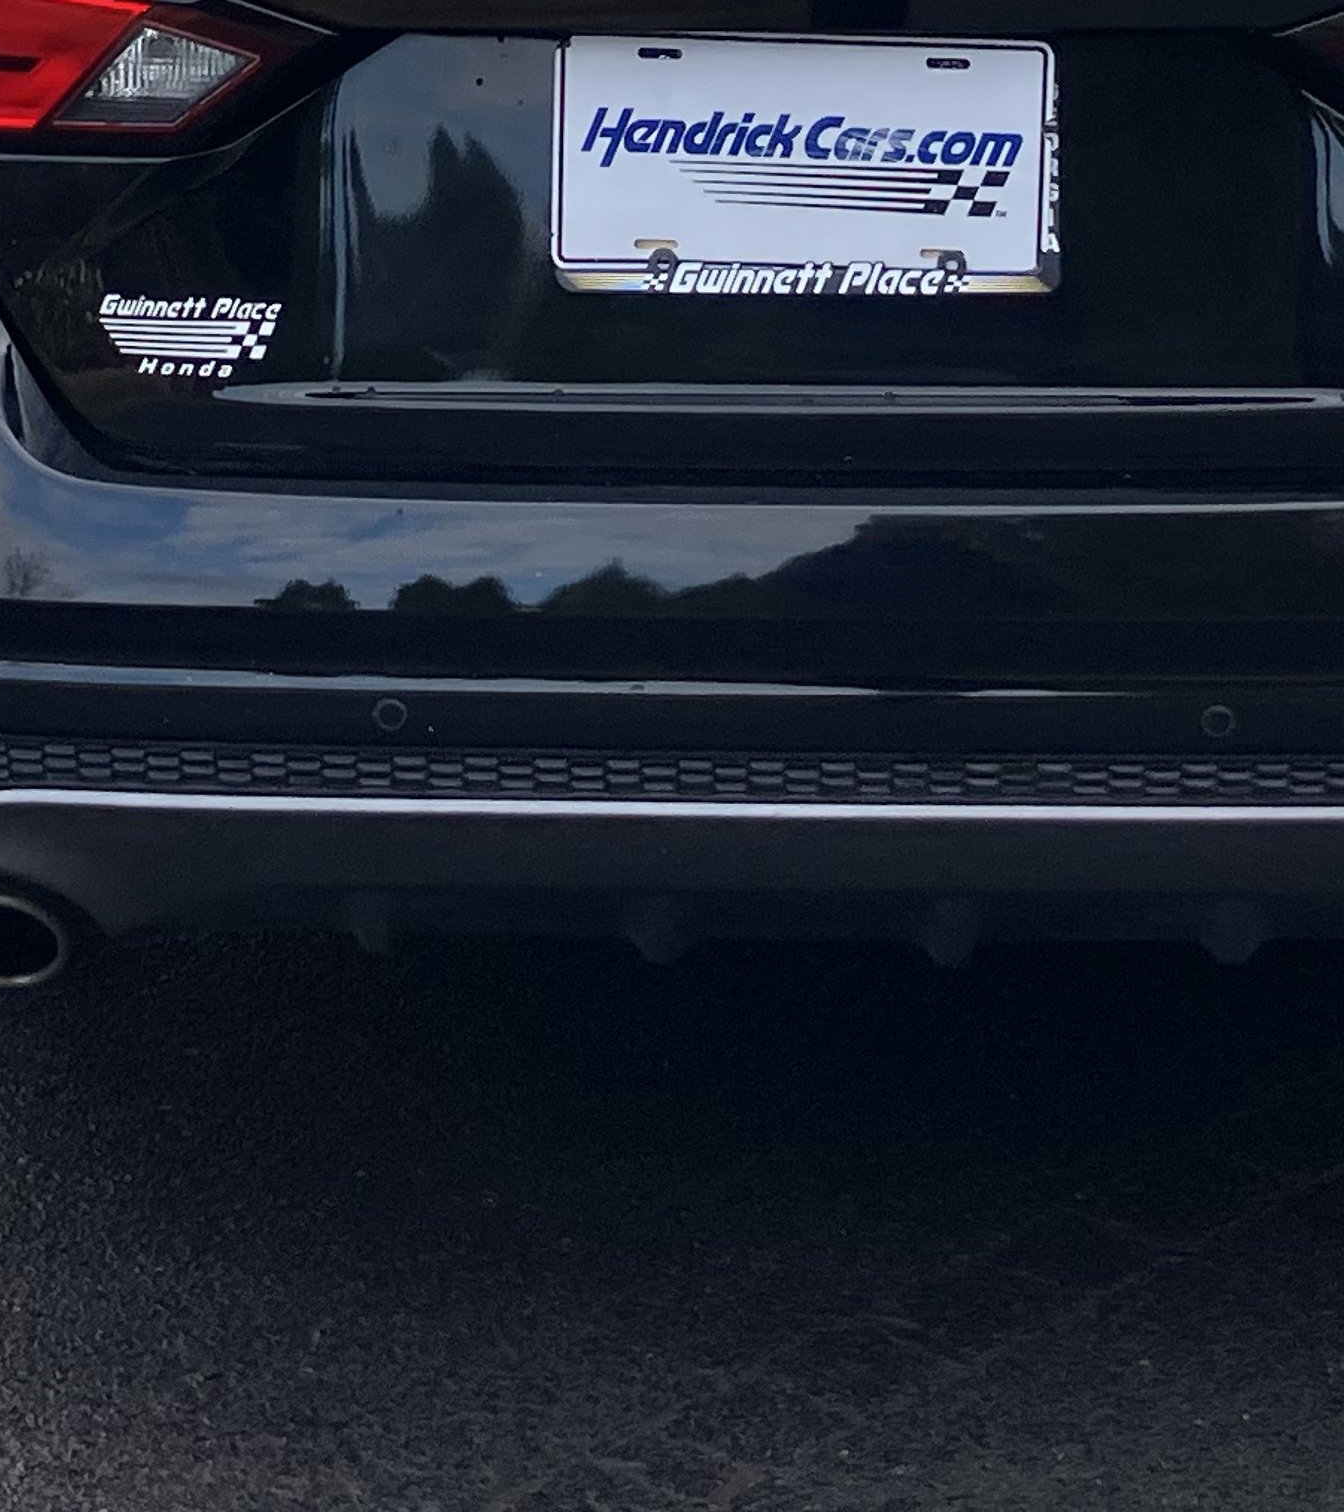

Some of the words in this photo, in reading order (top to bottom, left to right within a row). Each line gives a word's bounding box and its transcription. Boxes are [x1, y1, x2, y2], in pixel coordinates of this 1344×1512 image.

[581, 107, 803, 168] Hendrick
[668, 261, 834, 295] Gwinnett
[838, 261, 946, 296] Place
[99, 293, 207, 319] Gwinnett
[210, 297, 283, 321] Place
[137, 357, 234, 378] Honda
